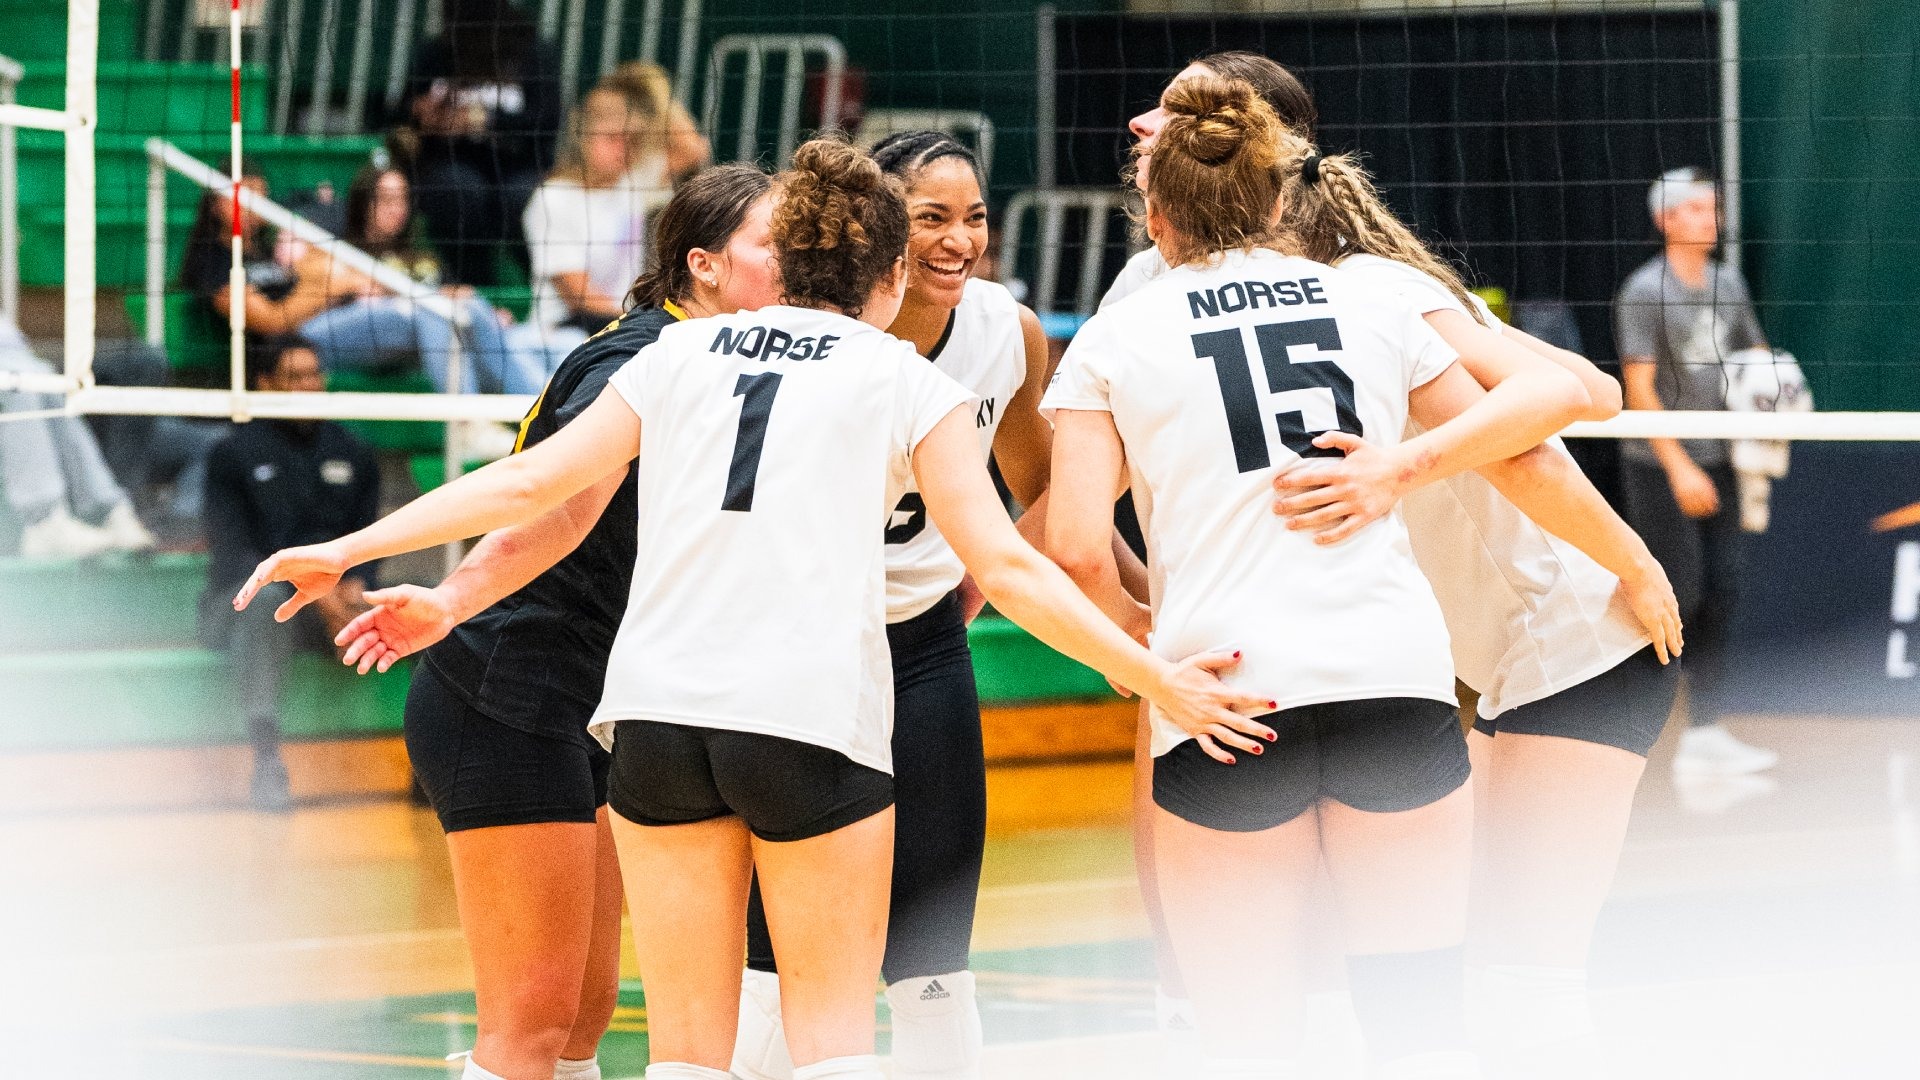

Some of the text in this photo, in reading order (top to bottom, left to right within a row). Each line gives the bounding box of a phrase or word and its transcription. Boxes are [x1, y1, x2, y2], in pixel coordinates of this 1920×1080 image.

[1187, 277, 1328, 319] NORSE
[709, 326, 841, 362] NORSE
[1190, 317, 1363, 474] 15
[721, 371, 783, 512] 1
[919, 991, 951, 1001] adidas
